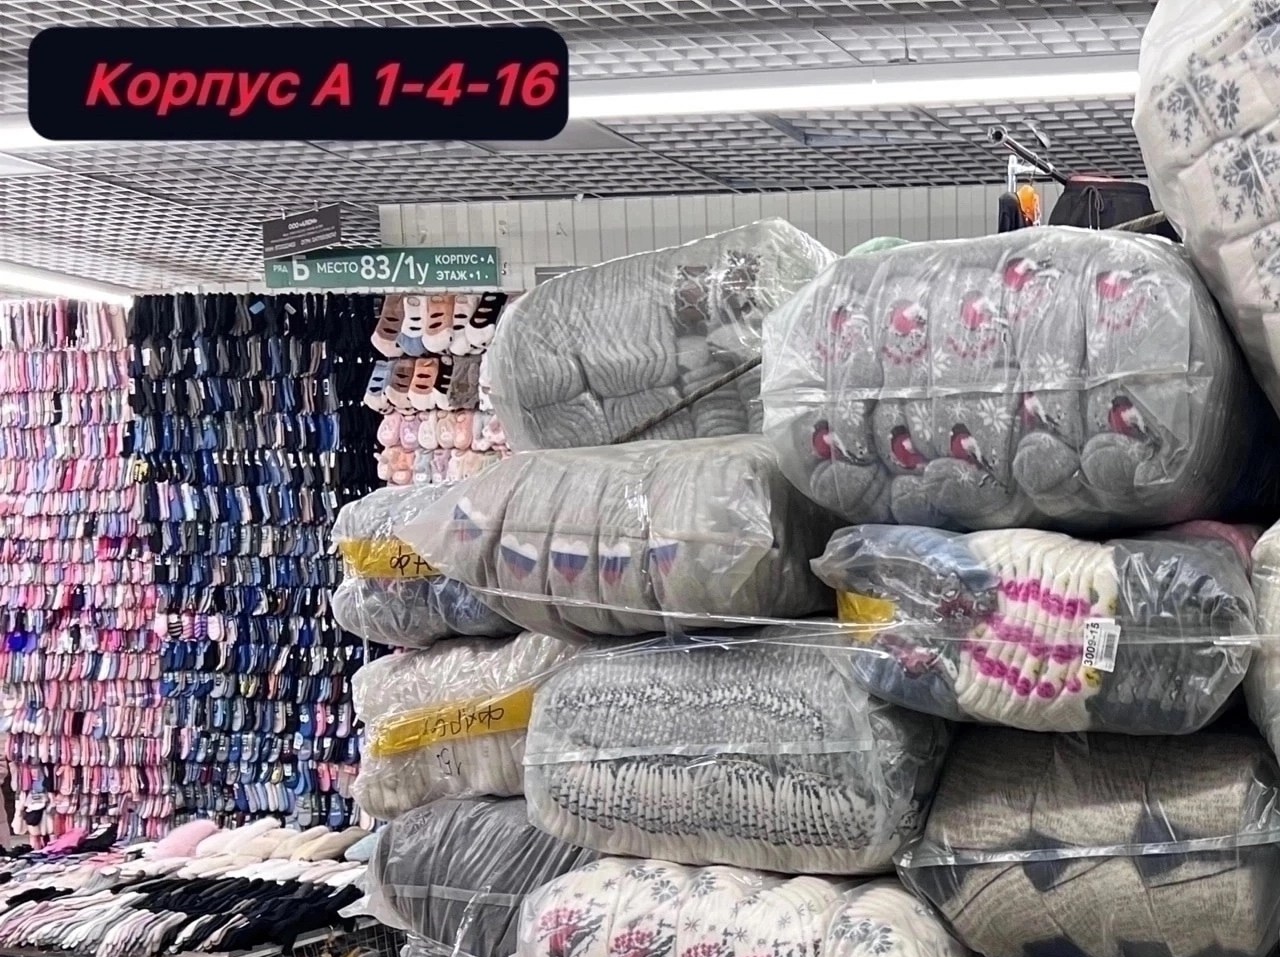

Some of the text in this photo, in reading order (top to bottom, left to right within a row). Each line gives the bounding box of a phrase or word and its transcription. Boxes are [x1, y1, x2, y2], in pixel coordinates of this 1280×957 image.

[434, 253, 495, 265] КОРПУС А
[273, 265, 289, 273] РЯД
[292, 254, 310, 281] Б
[316, 261, 359, 274] МЕСТО
[436, 270, 481, 281] ЭТАЖ 1
